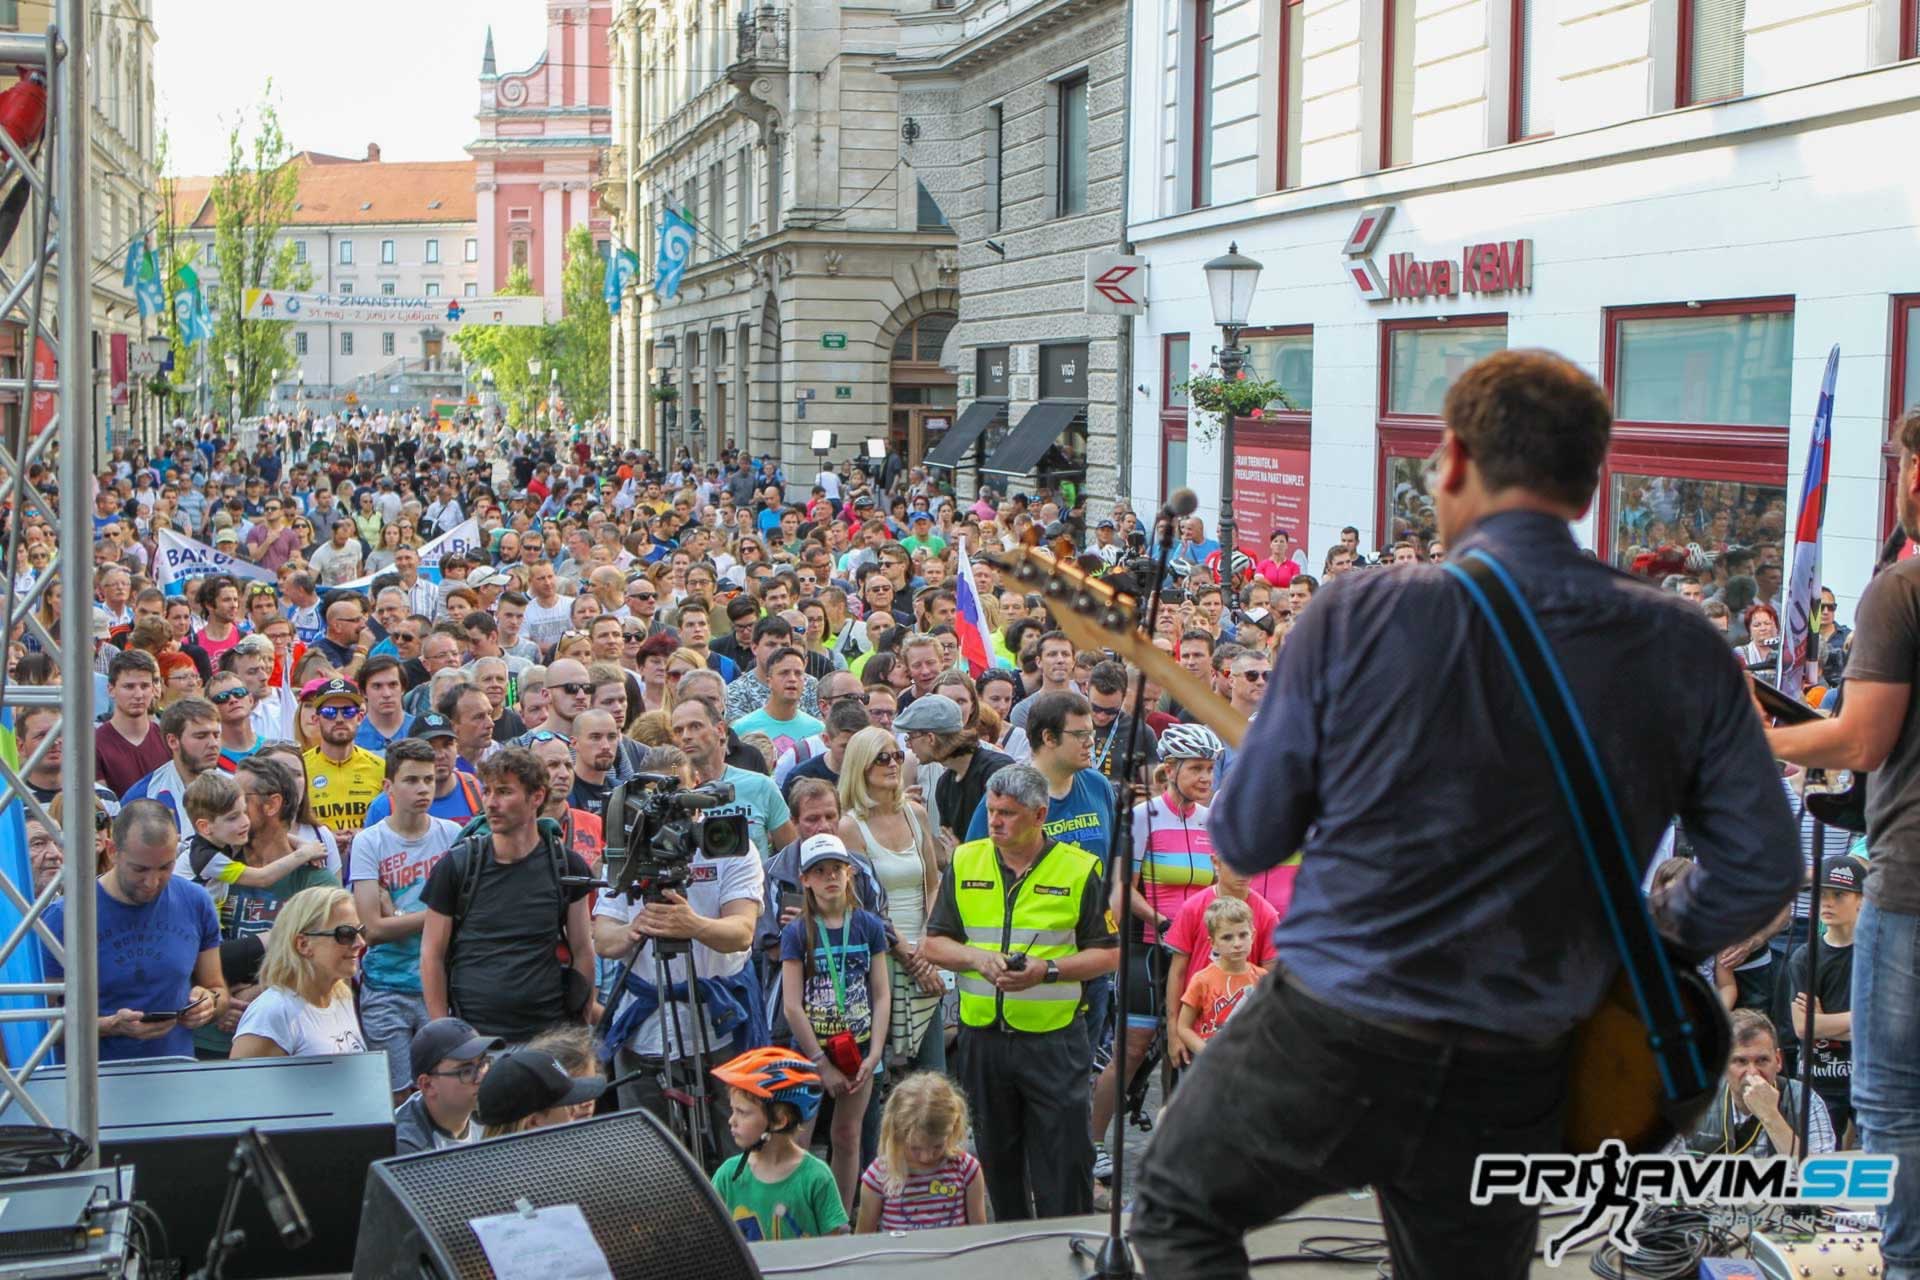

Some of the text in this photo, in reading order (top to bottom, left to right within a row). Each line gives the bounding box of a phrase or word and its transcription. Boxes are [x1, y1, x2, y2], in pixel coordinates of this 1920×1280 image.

[1388, 239, 1530, 298] Nova KBM
[339, 295, 433, 308] ZNANSTIVAL
[397, 310, 440, 322] Ljubljani
[1268, 472, 1282, 484] PAKET
[1282, 474, 1305, 487] KOMPLET.
[1042, 813, 1100, 837] SLOVENIJA
[378, 851, 408, 874] KEEP
